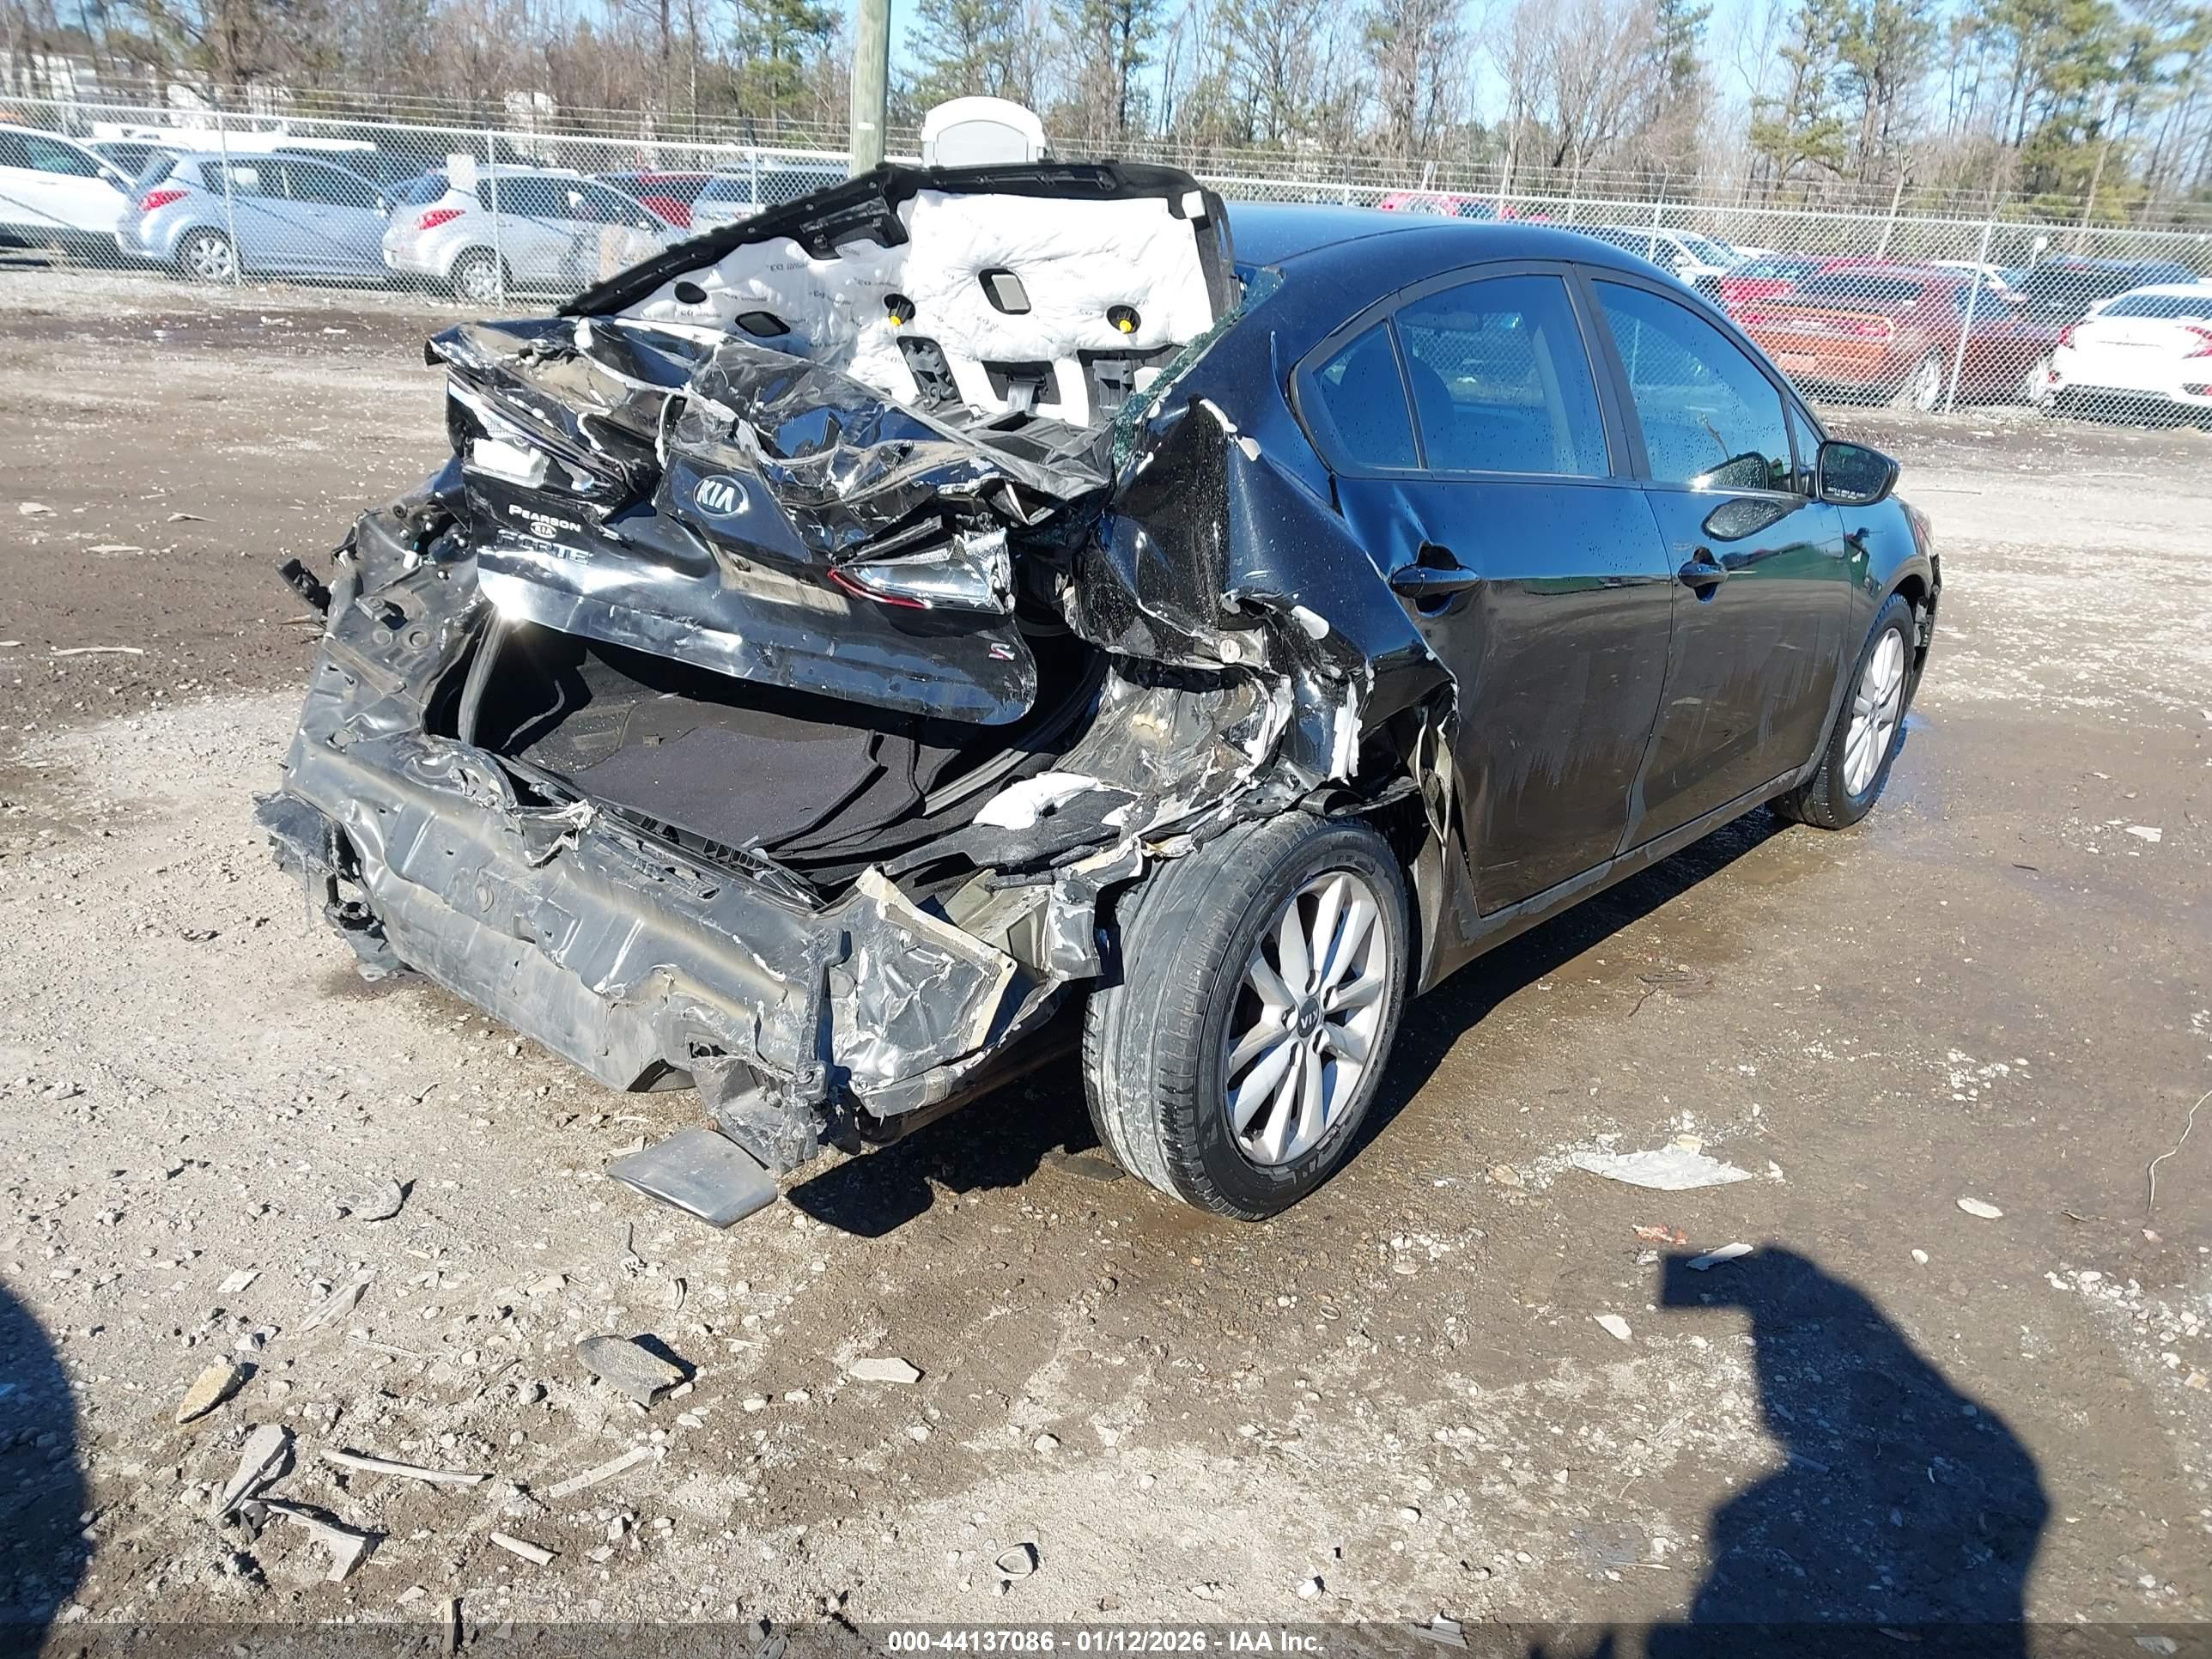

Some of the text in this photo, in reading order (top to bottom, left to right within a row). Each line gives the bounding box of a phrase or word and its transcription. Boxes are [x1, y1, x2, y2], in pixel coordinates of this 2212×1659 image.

[696, 479, 735, 512] KIA
[508, 504, 581, 532] PEARSON
[533, 524, 554, 536] KIA
[497, 529, 590, 565] FORTE
[1301, 1007, 1318, 1029] KIA
